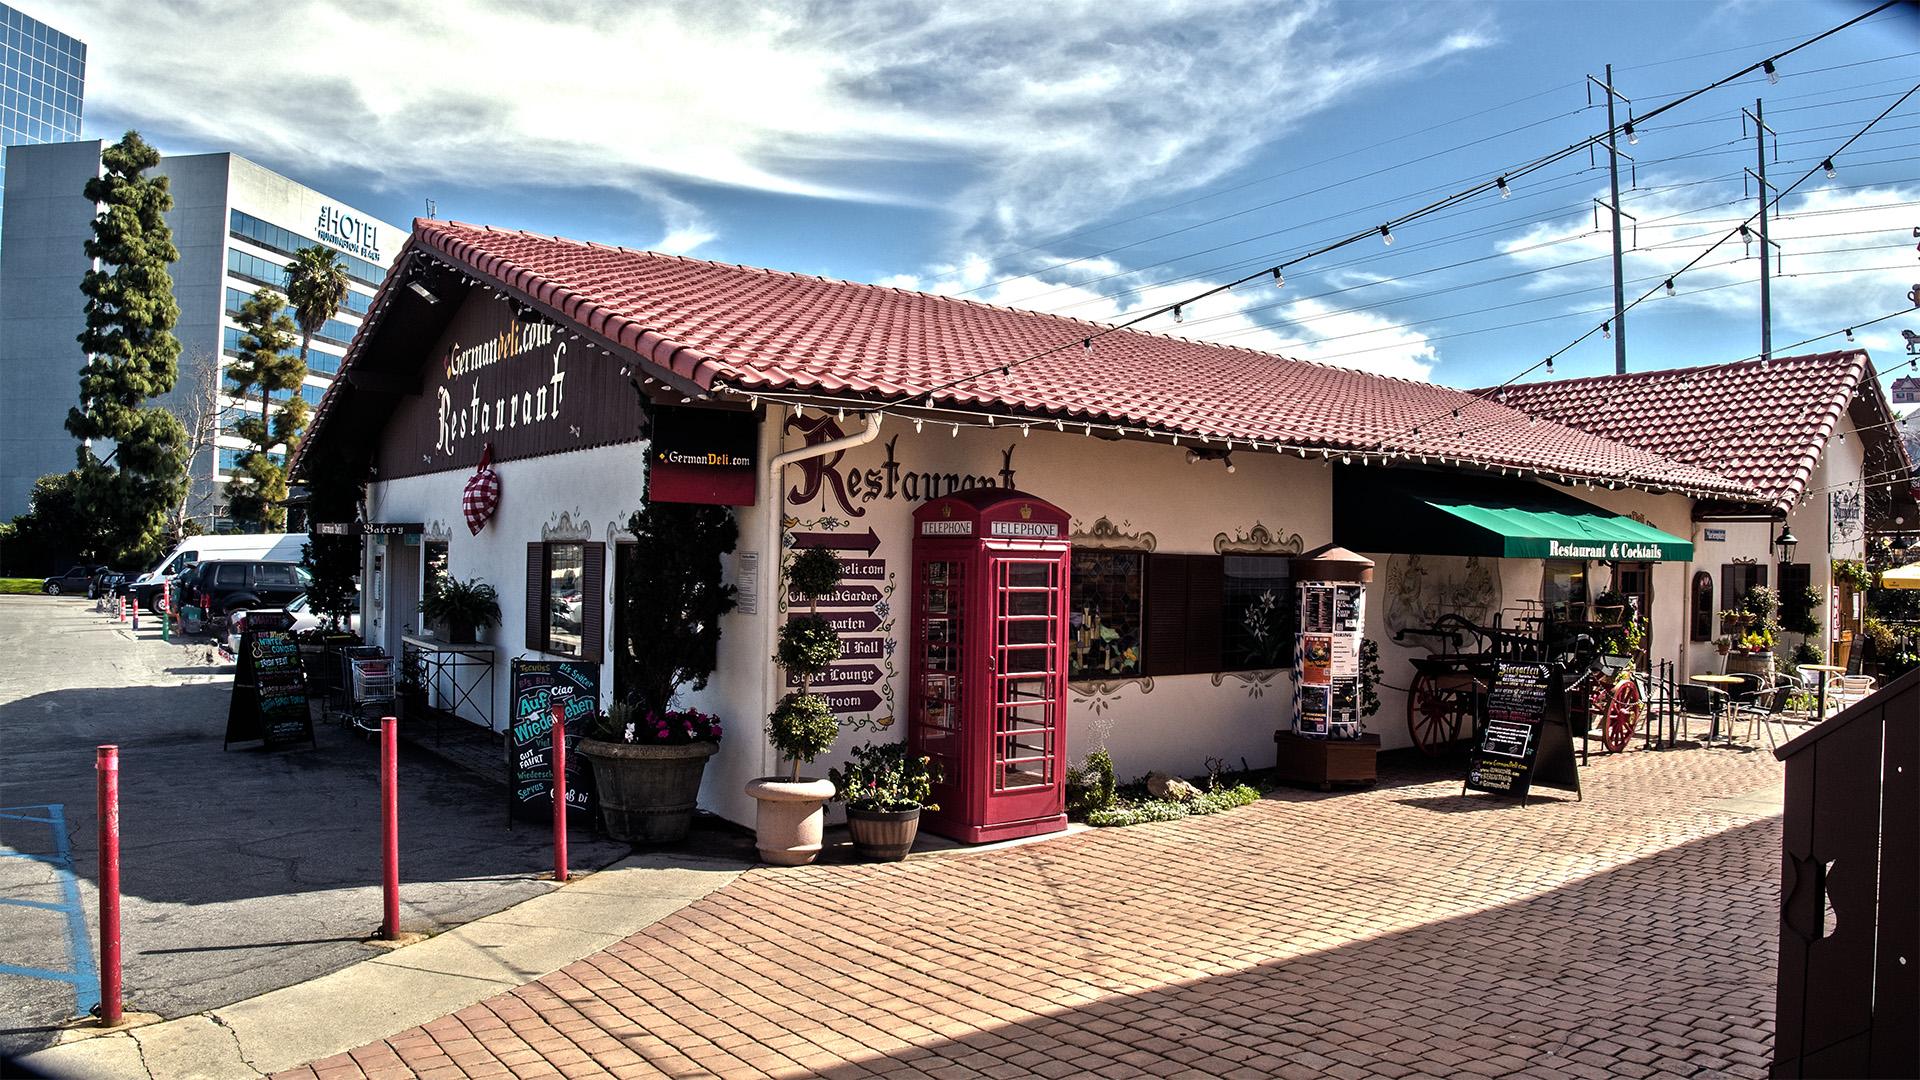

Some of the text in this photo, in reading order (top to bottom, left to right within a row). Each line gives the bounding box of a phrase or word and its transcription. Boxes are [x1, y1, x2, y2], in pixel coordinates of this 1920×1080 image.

[327, 206, 379, 252] HOTEL
[436, 341, 567, 456] Restaurant
[363, 523, 404, 535] Bakery
[924, 521, 972, 535] TELEPHONE
[993, 523, 1056, 536] TELEPHONE
[1549, 540, 1662, 559] Restaurant & Cocktails
[829, 668, 875, 683] Lounge
[1498, 663, 1539, 677] Biergarten
[551, 685, 574, 696] Ciao
[520, 691, 548, 716] Auf
[519, 749, 534, 761] GUT
[519, 754, 544, 769] FAHRT
[517, 782, 544, 800] Servus
